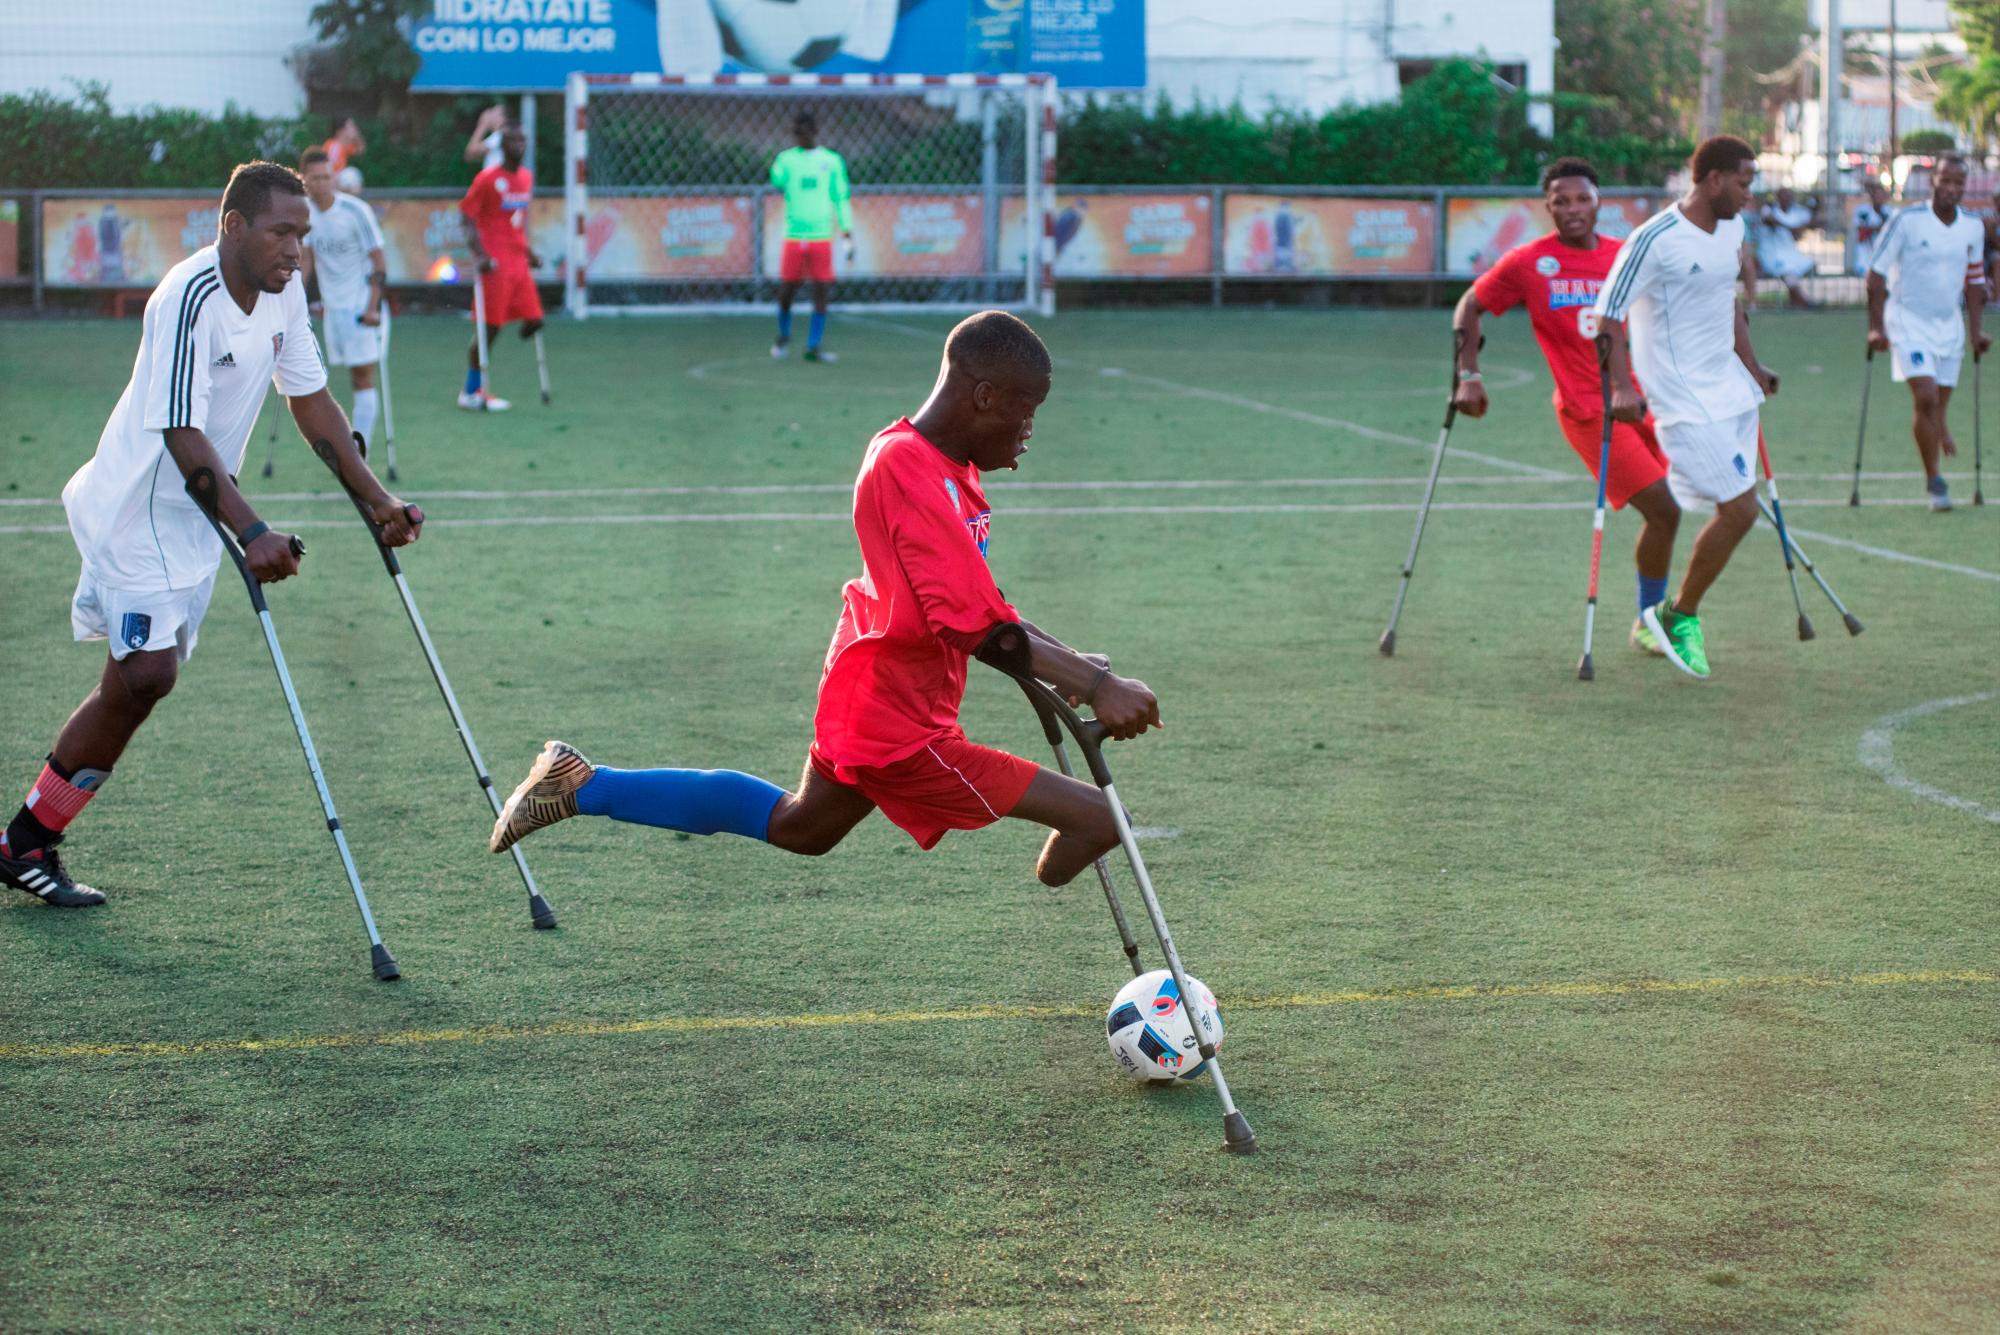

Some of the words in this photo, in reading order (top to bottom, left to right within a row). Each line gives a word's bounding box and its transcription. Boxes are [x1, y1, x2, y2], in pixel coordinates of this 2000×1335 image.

[415, 26, 479, 52] CON
[482, 26, 520, 52] LO
[523, 26, 615, 52] MEJOR
